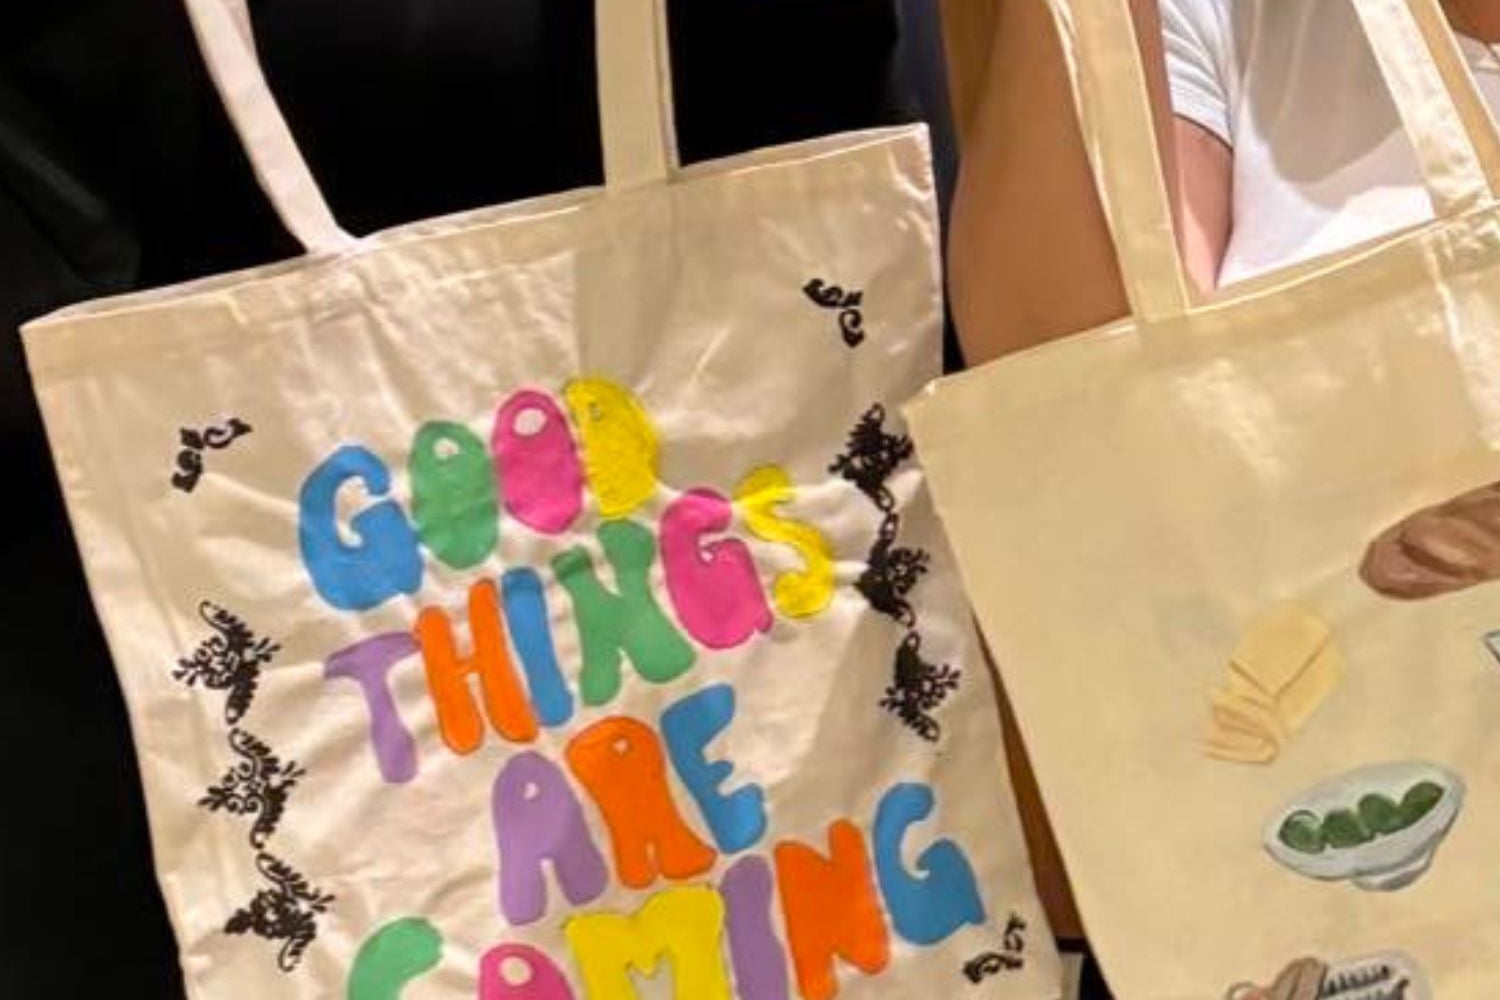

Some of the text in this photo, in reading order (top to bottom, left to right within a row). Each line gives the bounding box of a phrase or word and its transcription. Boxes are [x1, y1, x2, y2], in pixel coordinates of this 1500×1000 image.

[299, 377, 661, 611] GOOD
[323, 465, 834, 784] THINGS
[490, 684, 766, 926] ARE
